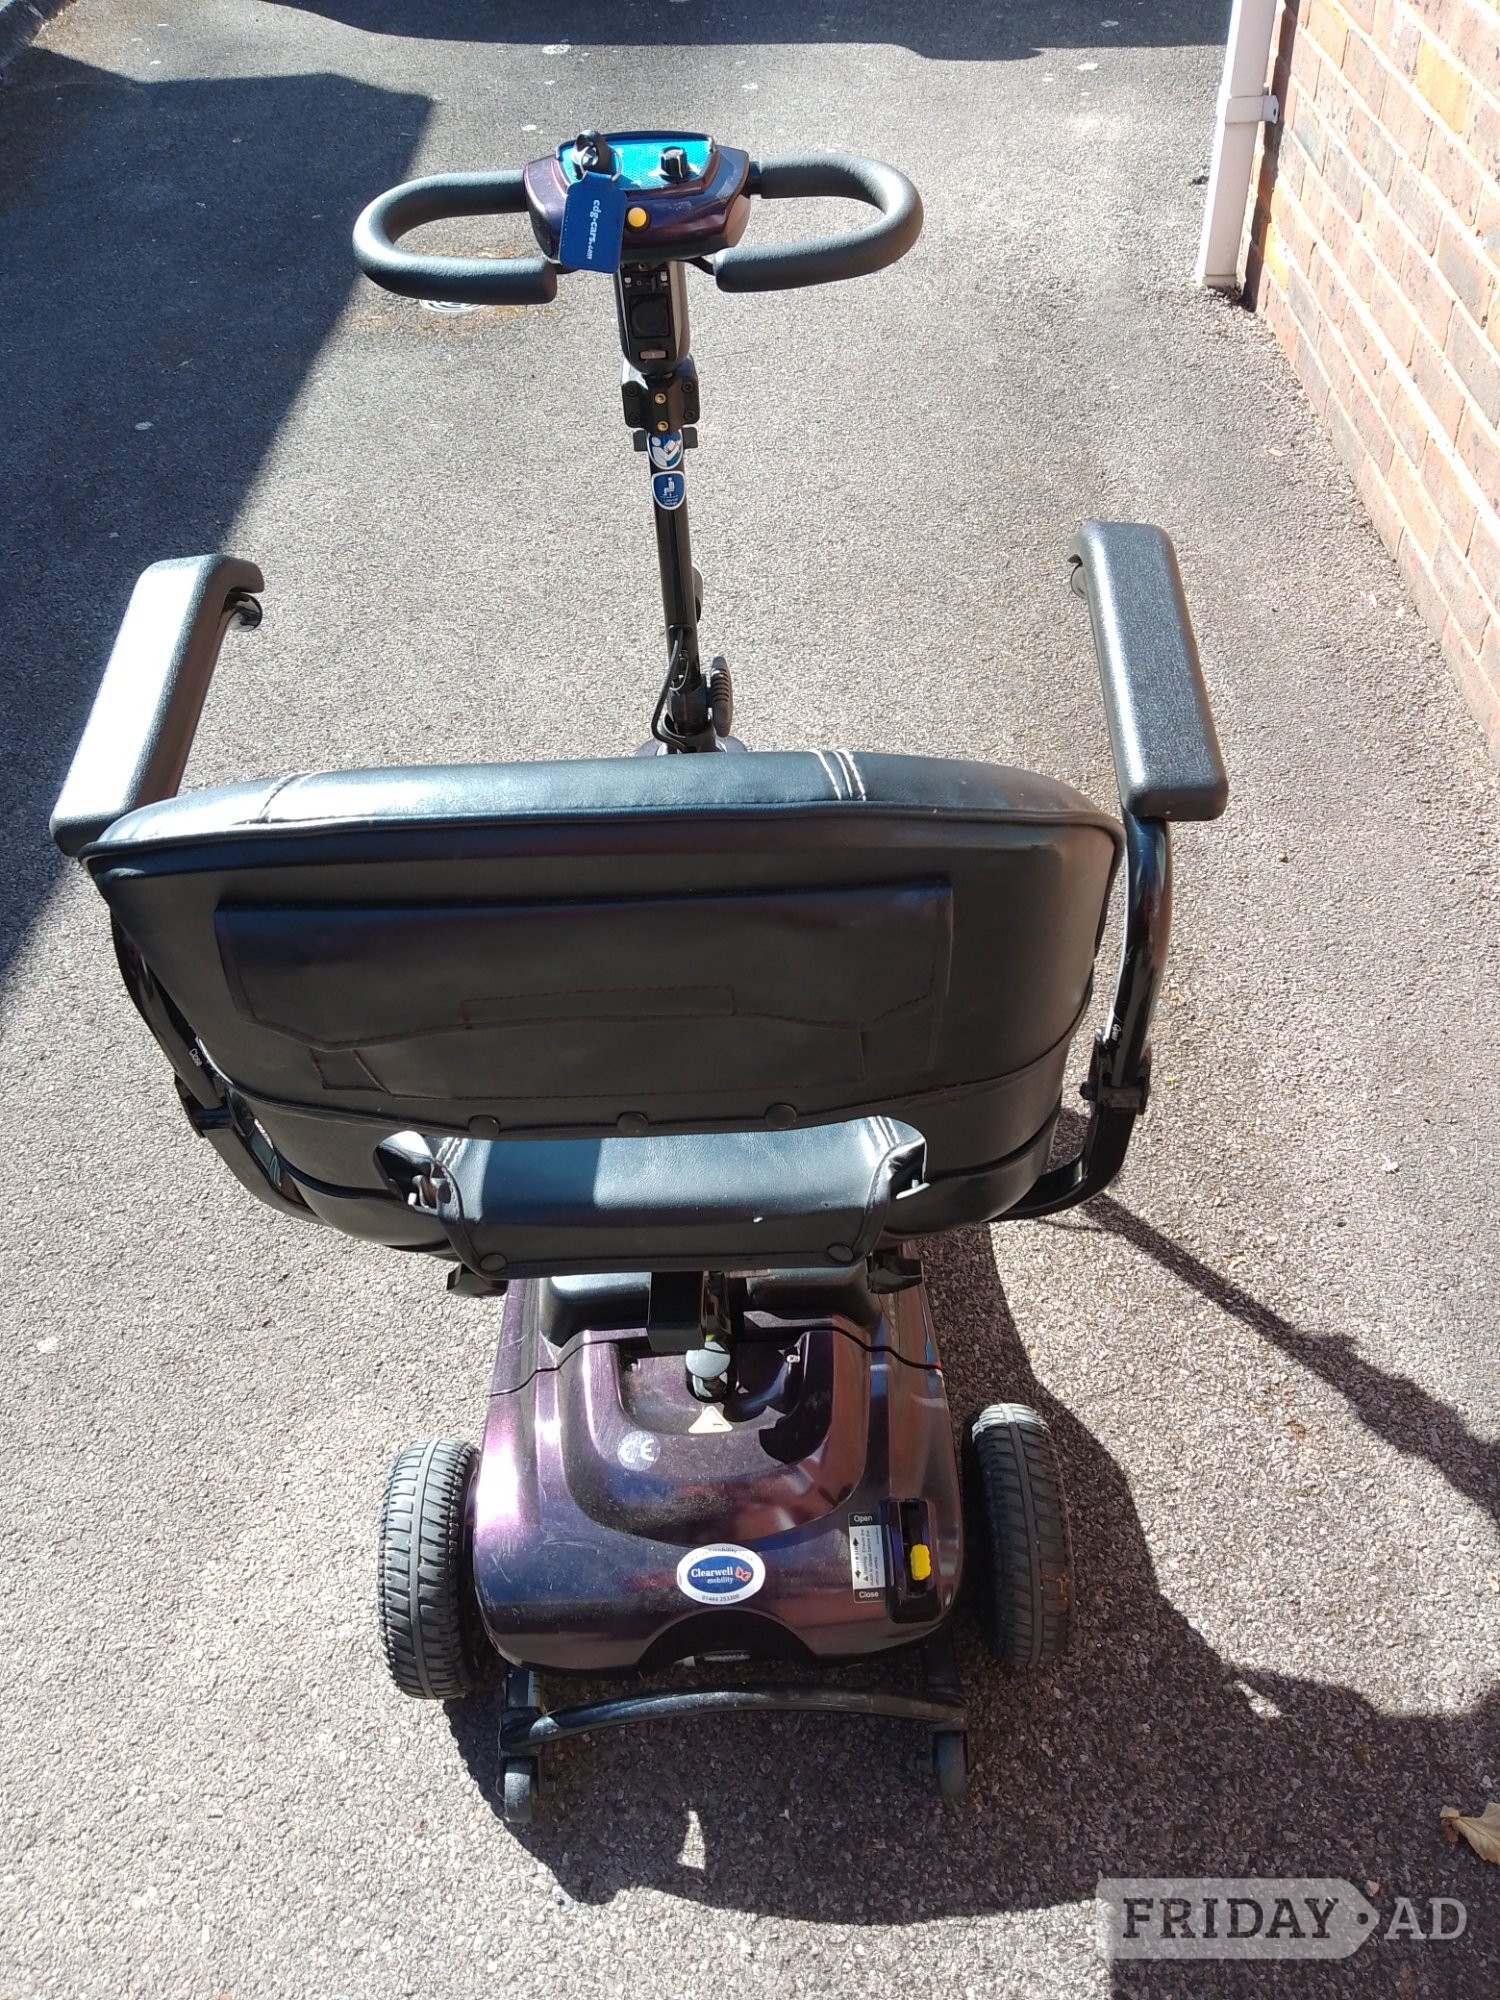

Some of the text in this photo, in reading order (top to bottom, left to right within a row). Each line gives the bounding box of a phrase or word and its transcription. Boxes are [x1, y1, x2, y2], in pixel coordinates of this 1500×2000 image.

[620, 1439, 655, 1463] CE
[853, 1515, 873, 1523] Open
[691, 1566, 733, 1578] Clearwell
[707, 1576, 734, 1584] mobility
